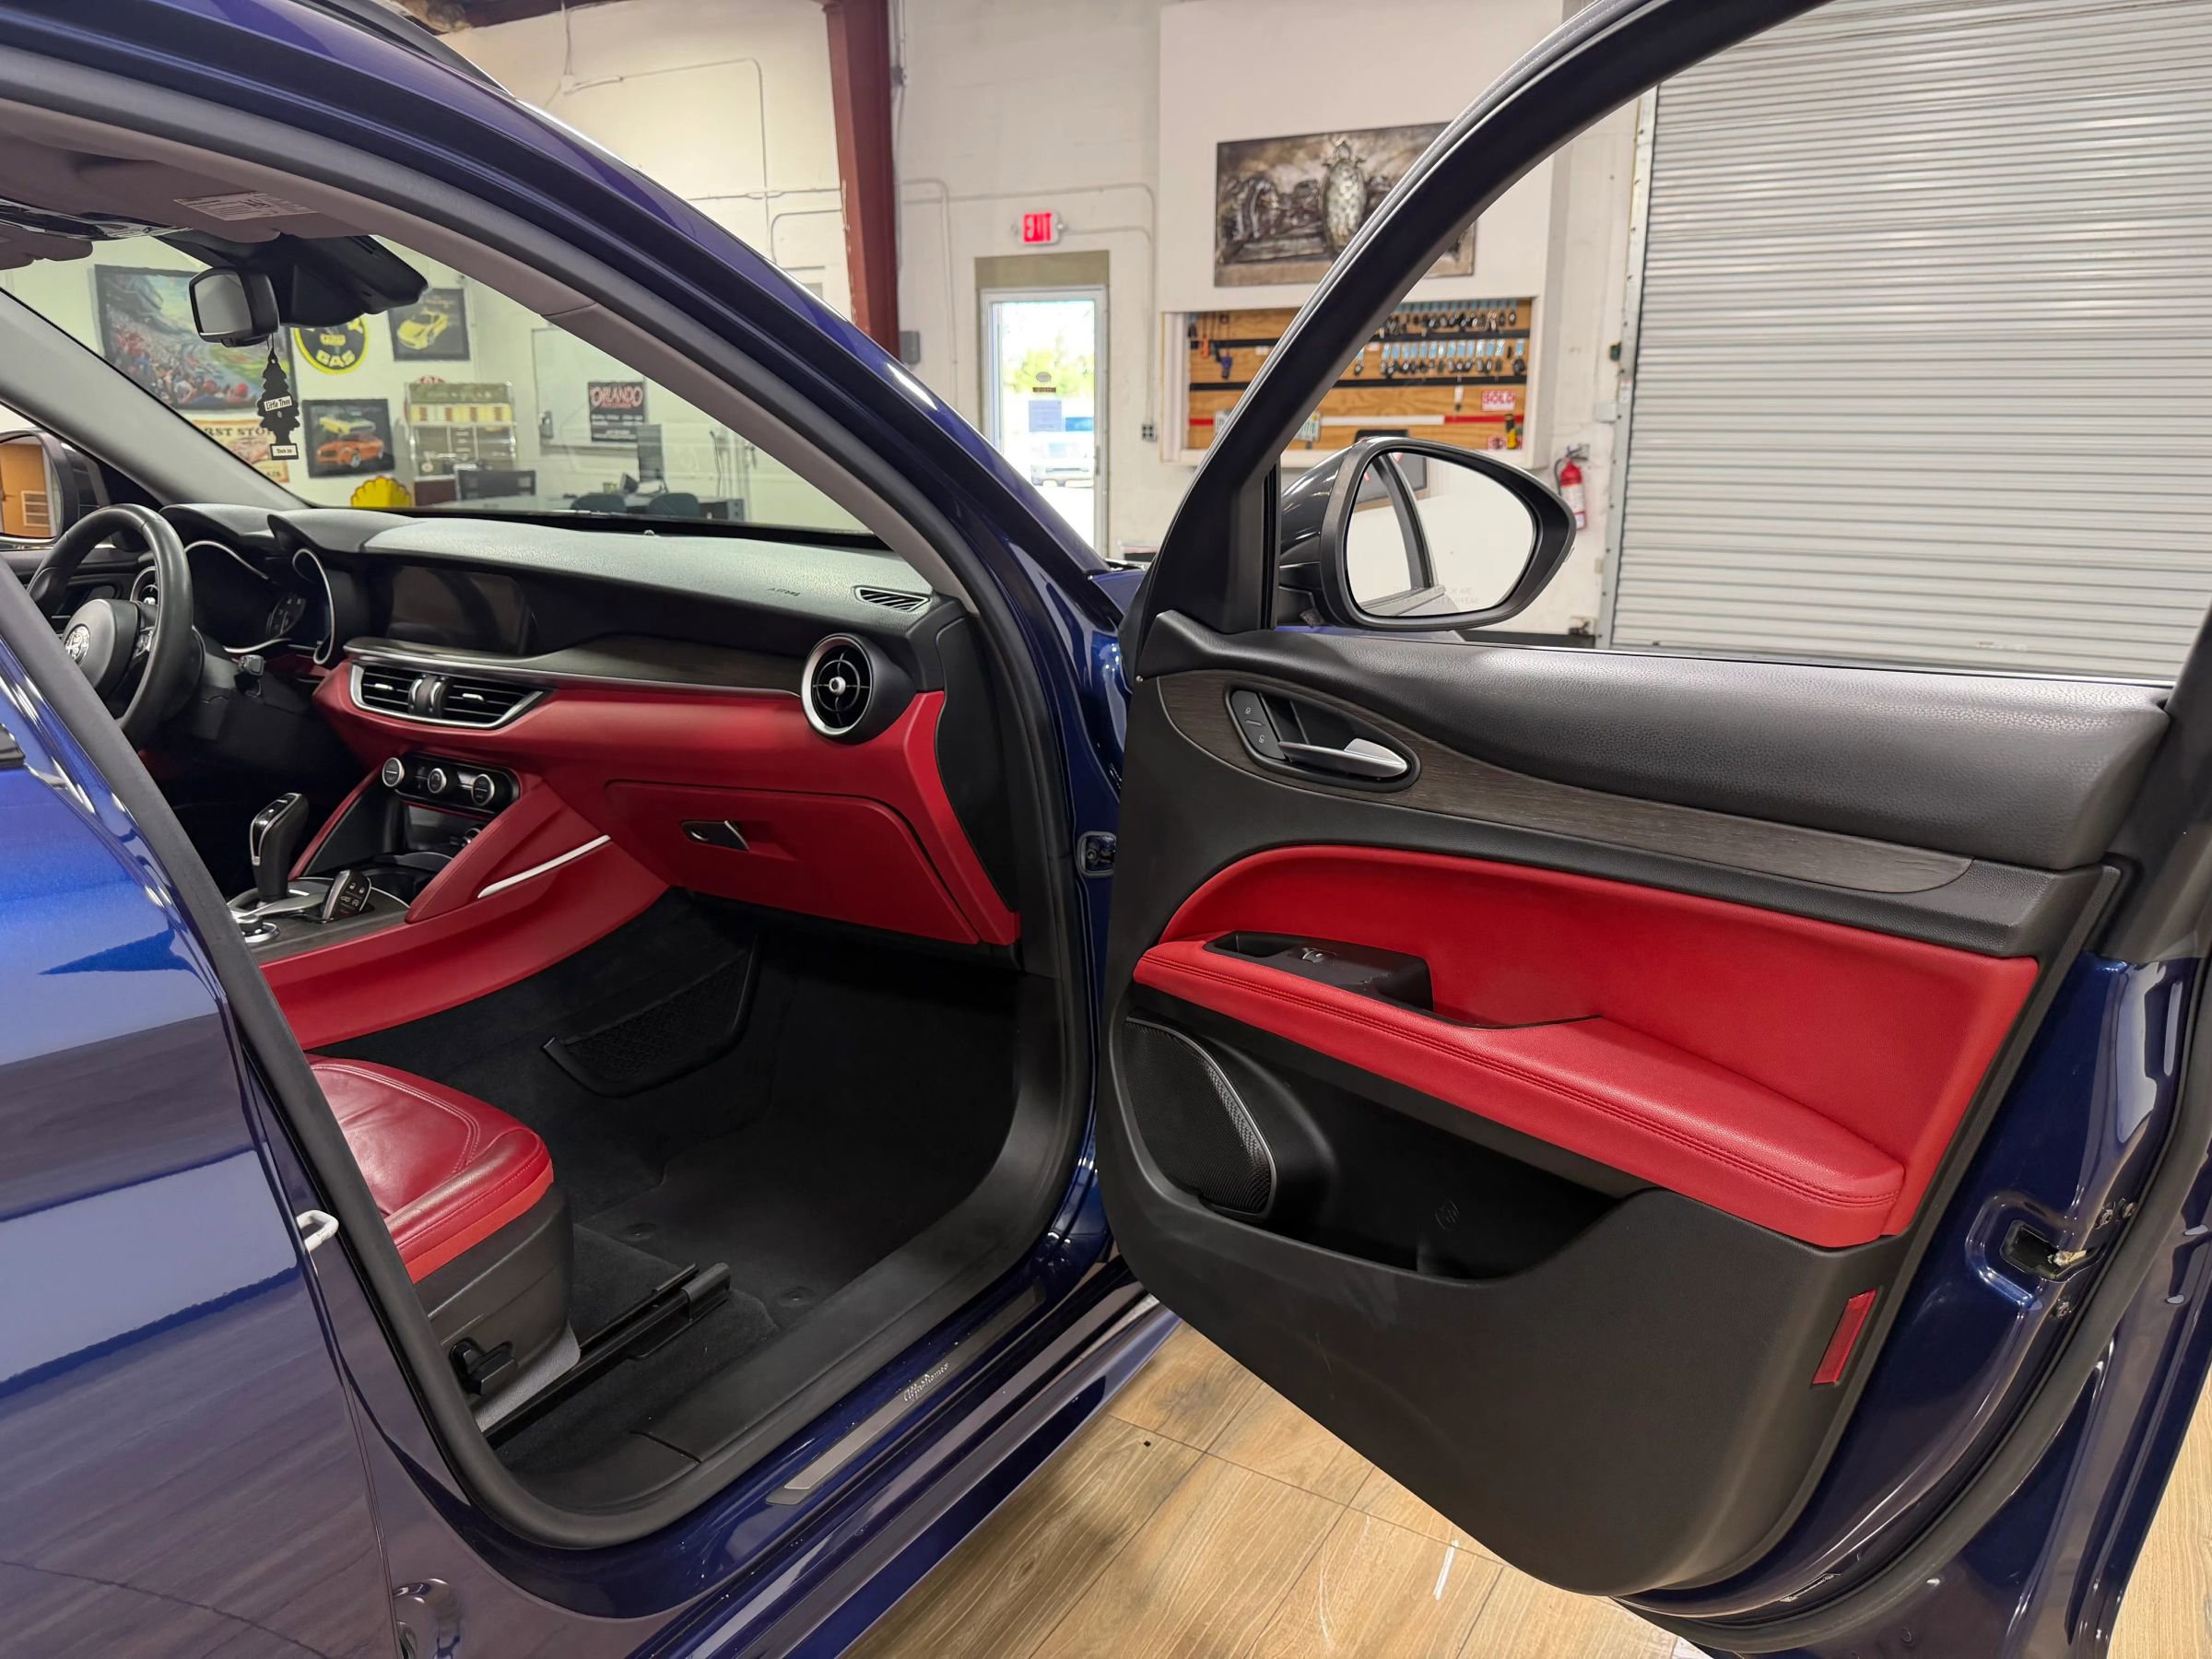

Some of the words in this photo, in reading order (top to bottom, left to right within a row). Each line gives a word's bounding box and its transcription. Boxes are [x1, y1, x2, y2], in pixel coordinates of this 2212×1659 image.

[1023, 212, 1053, 242] EXIT
[316, 349, 356, 368] GAS
[590, 385, 643, 407] ORLANDO
